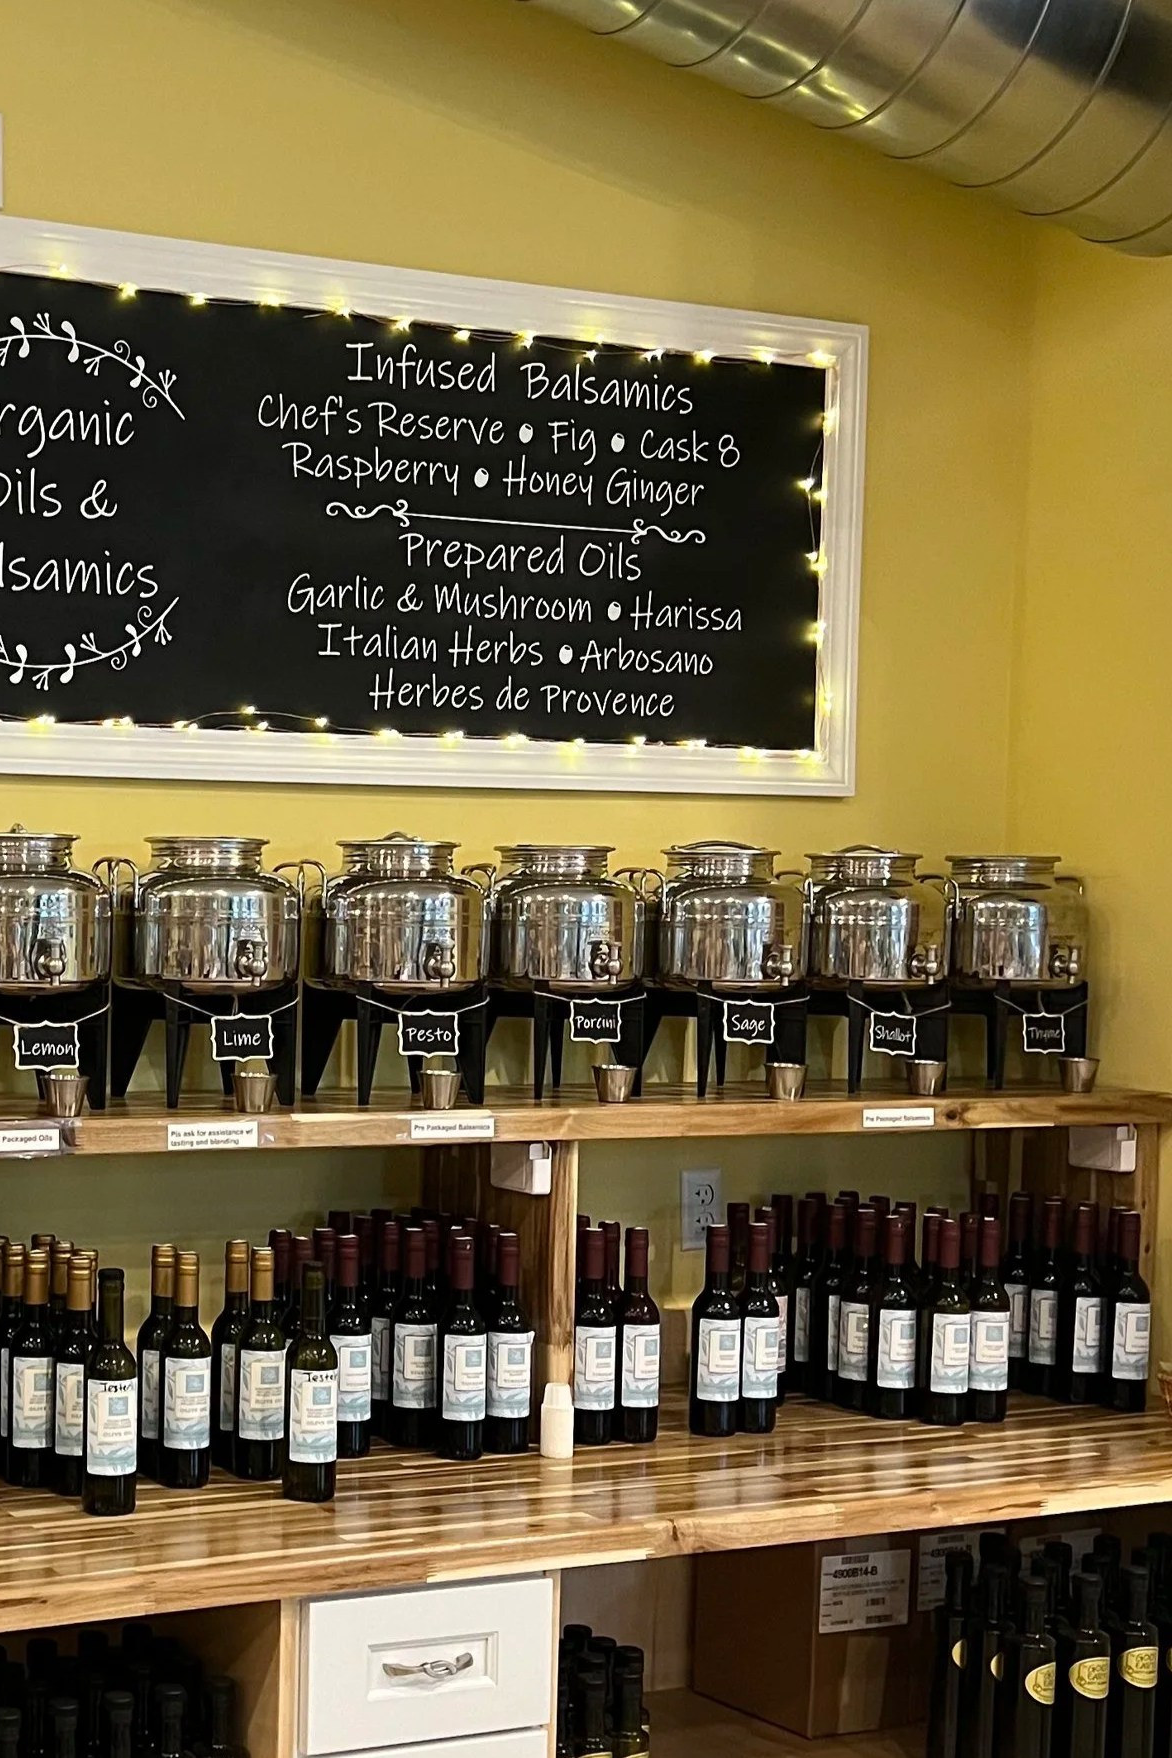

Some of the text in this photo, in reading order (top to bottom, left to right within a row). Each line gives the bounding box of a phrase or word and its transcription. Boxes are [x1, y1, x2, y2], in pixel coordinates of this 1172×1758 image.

[346, 341, 692, 414] Infused Balsamics
[258, 394, 740, 467] Chef's Reserve Fig Cask 8
[282, 442, 704, 516] Raspberry Honey Ginger
[80, 480, 117, 519] &
[399, 533, 641, 580] Prepared Oils
[288, 573, 741, 630] Garlic & Mushroom Harissa
[318, 624, 713, 675] Italian Herbs Arbosano
[369, 668, 674, 716] Herbes de Provence
[575, 1014, 616, 1030] Porcini
[731, 1014, 766, 1037] Sage
[223, 1030, 262, 1047] Lime
[406, 1027, 453, 1043] Pesto
[875, 1024, 912, 1043] Shallot
[21, 1040, 75, 1056] Lemon
[208, 1128, 244, 1137] assistance
[427, 1124, 457, 1132] Packaged
[2, 1135, 37, 1144] Packaged
[171, 1140, 194, 1148] tasting
[210, 1138, 240, 1147] blending
[98, 1382, 133, 1394] Tester
